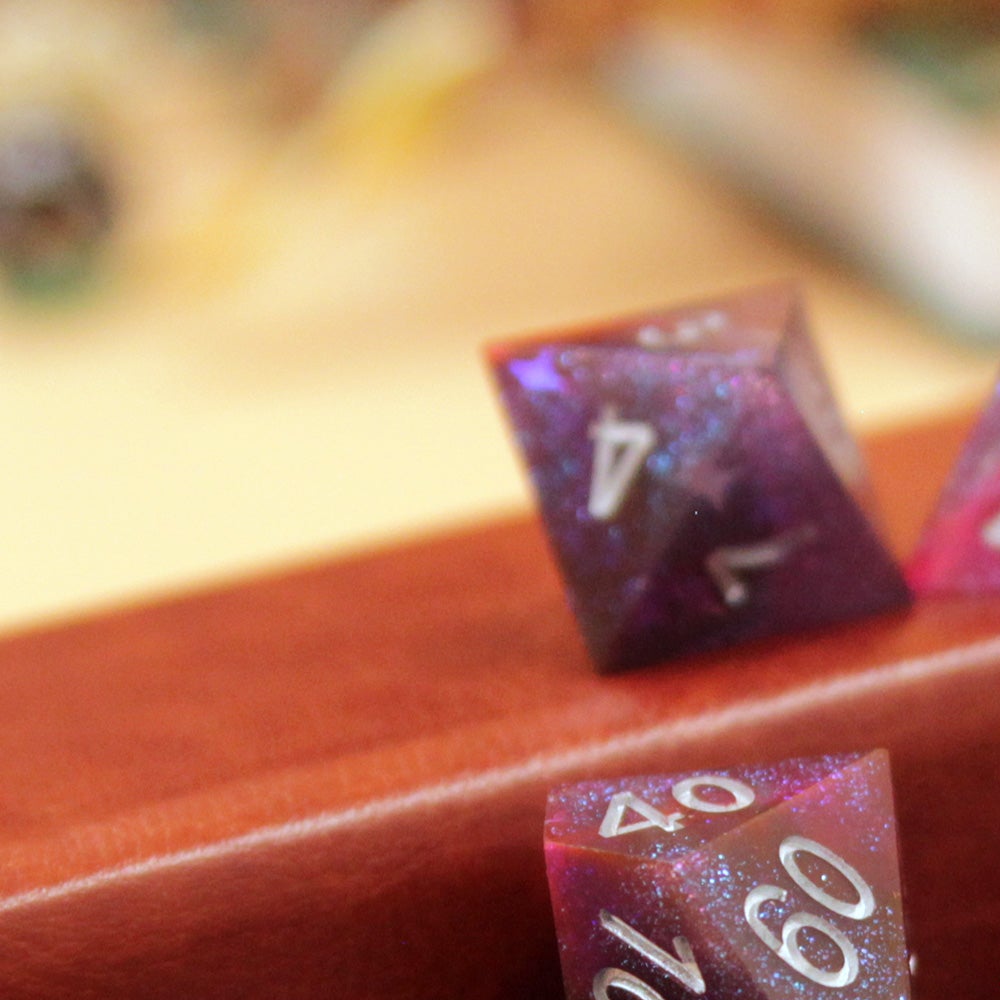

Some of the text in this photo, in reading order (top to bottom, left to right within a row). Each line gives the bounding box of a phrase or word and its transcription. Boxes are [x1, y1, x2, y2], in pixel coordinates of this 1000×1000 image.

[589, 406, 656, 519] 4
[598, 775, 756, 838] 40
[744, 835, 875, 988] 60
